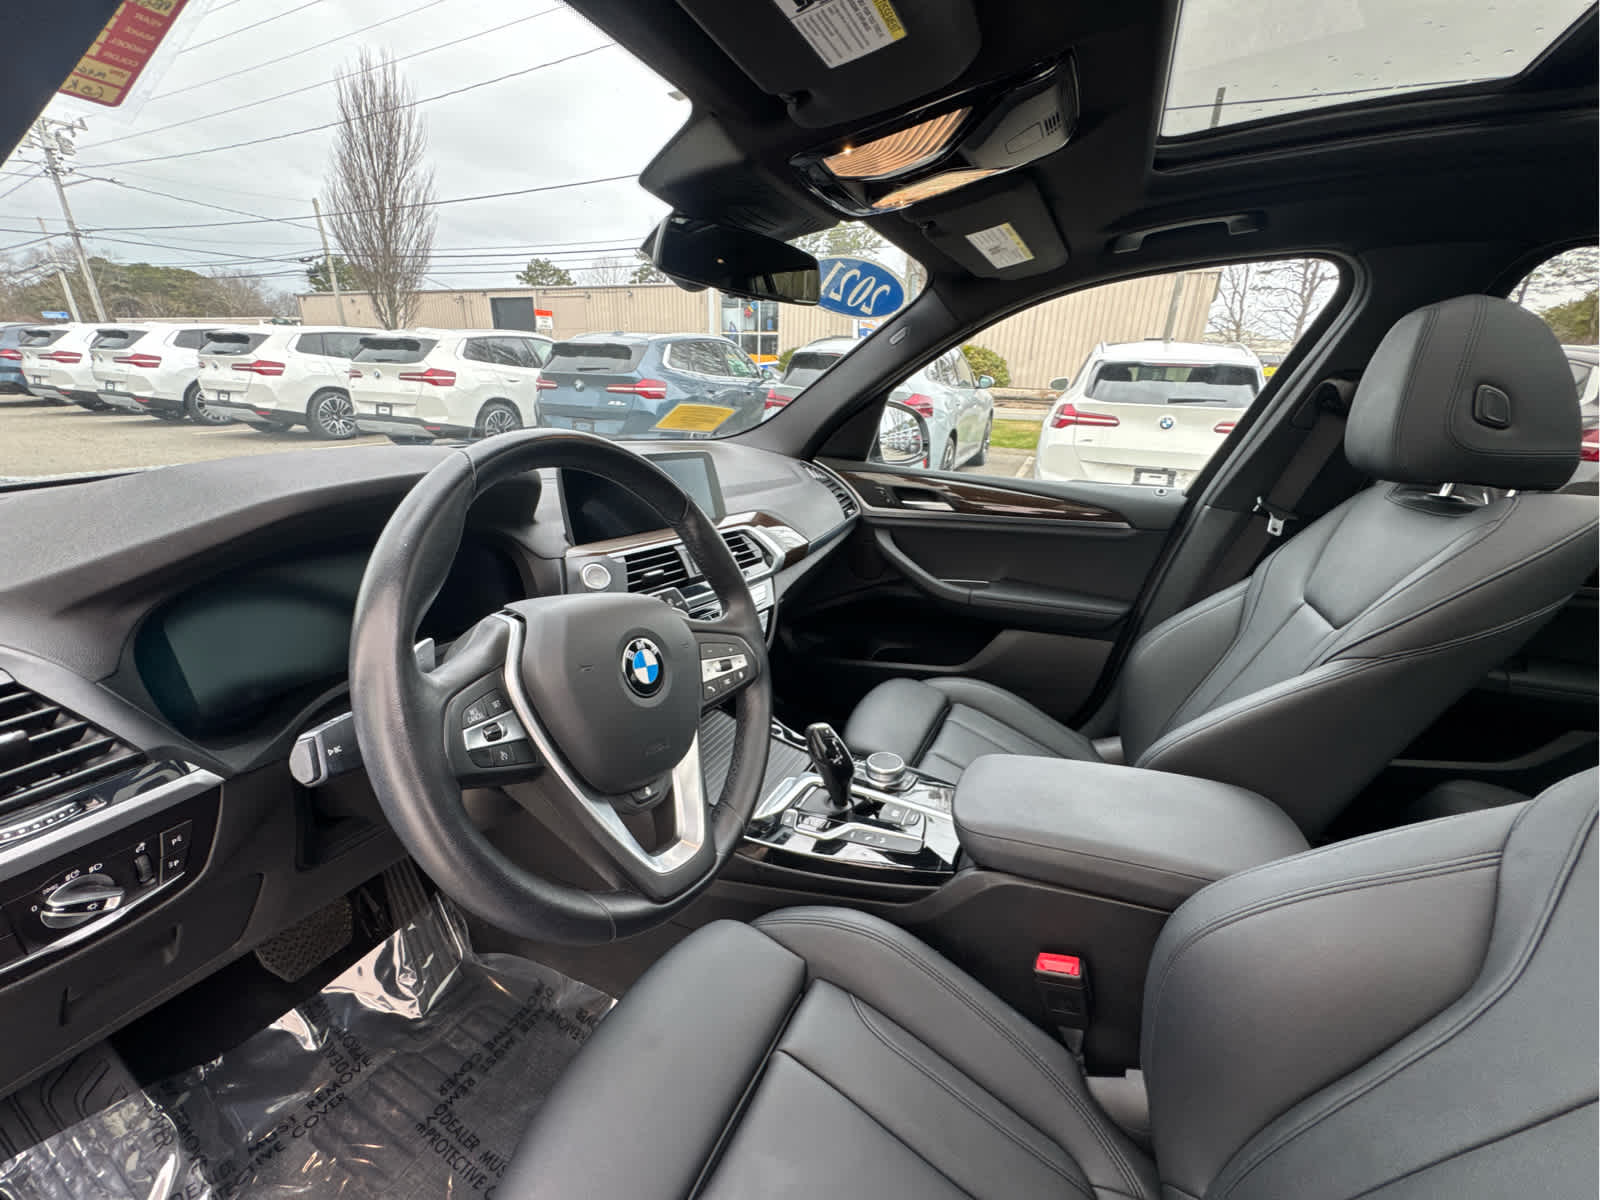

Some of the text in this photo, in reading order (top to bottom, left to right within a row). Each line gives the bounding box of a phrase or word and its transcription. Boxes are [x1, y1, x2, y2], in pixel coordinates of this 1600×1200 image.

[626, 639, 660, 661] BMW
[304, 1053, 373, 1111] REMOVE
[437, 1051, 482, 1097] COVER
[291, 1091, 350, 1140] COVER
[425, 1127, 488, 1190] PROTECTIVE
[439, 1112, 507, 1180] DEALER MUS
